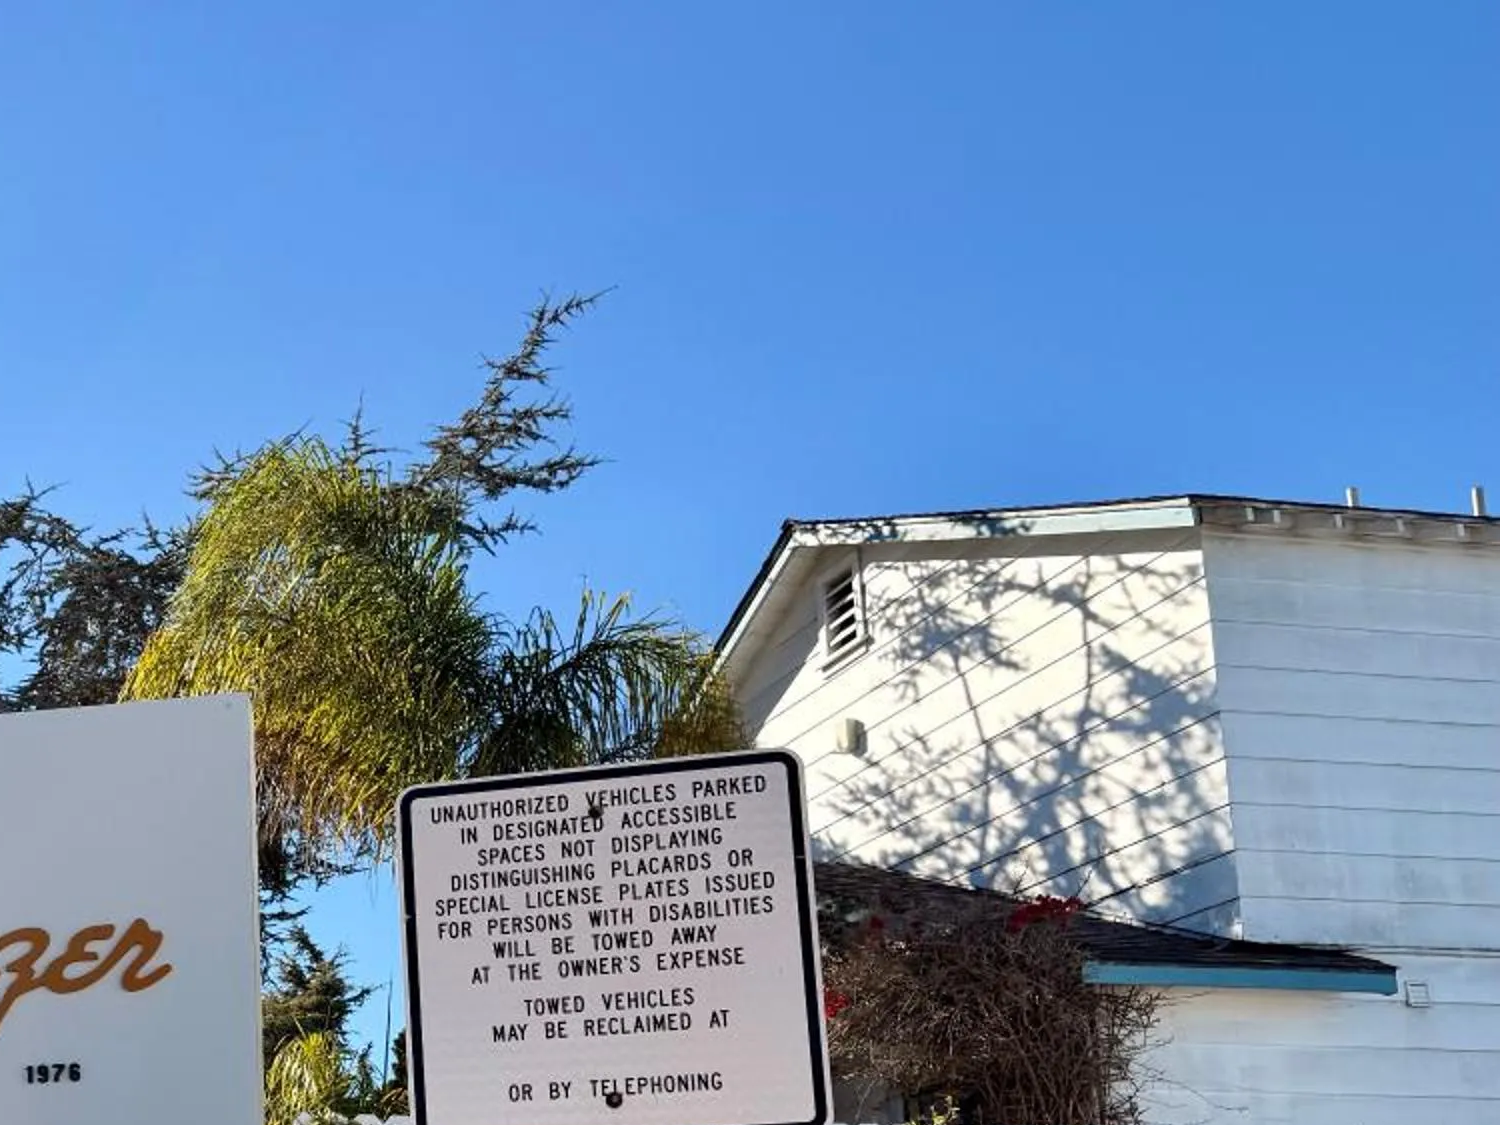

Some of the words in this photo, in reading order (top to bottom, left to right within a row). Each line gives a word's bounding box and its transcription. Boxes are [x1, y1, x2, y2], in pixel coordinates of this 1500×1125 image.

[431, 794, 569, 824] UNAUTHORIZED
[586, 784, 677, 812] VEHICLES
[692, 775, 767, 799] PARKED
[461, 826, 478, 845] IN
[493, 815, 605, 841] DESIGNATED
[621, 802, 737, 830] ACCESSIBLE
[478, 843, 546, 867] SPACES
[561, 839, 596, 859] NOT
[612, 828, 723, 855] DISPLAYING
[451, 863, 596, 893] DISTINGUISHING
[612, 852, 712, 878] PLACARDS
[728, 849, 754, 867] OR
[436, 895, 511, 917] SPECIAL
[526, 886, 604, 909] LICENSE
[620, 879, 690, 901] PLATES
[706, 871, 776, 894] ISSUED
[438, 922, 472, 940] FOR
[488, 912, 573, 936] PERSONS
[589, 907, 633, 928] WITH
[649, 896, 774, 923] DISABILITIES
[493, 940, 536, 959] WILL
[552, 936, 574, 955] BE
[592, 930, 653, 952] TOWED
[672, 925, 718, 946] AWAY
[472, 966, 490, 984] AT
[508, 963, 542, 982] THE
[558, 955, 641, 978] OWNER'S
[657, 947, 745, 971] EXPENSE
[524, 995, 585, 1017] TOWED
[602, 988, 695, 1010] VEHICLES
[493, 1024, 528, 1043] MAY
[545, 1020, 567, 1040] BE
[584, 1012, 692, 1037] RECLAIMED
[710, 1010, 730, 1029] AT
[24, 1063, 82, 1084] 1976
[509, 1083, 533, 1102] OR
[550, 1081, 571, 1100] BY
[590, 1072, 723, 1098] TELEPHONING
